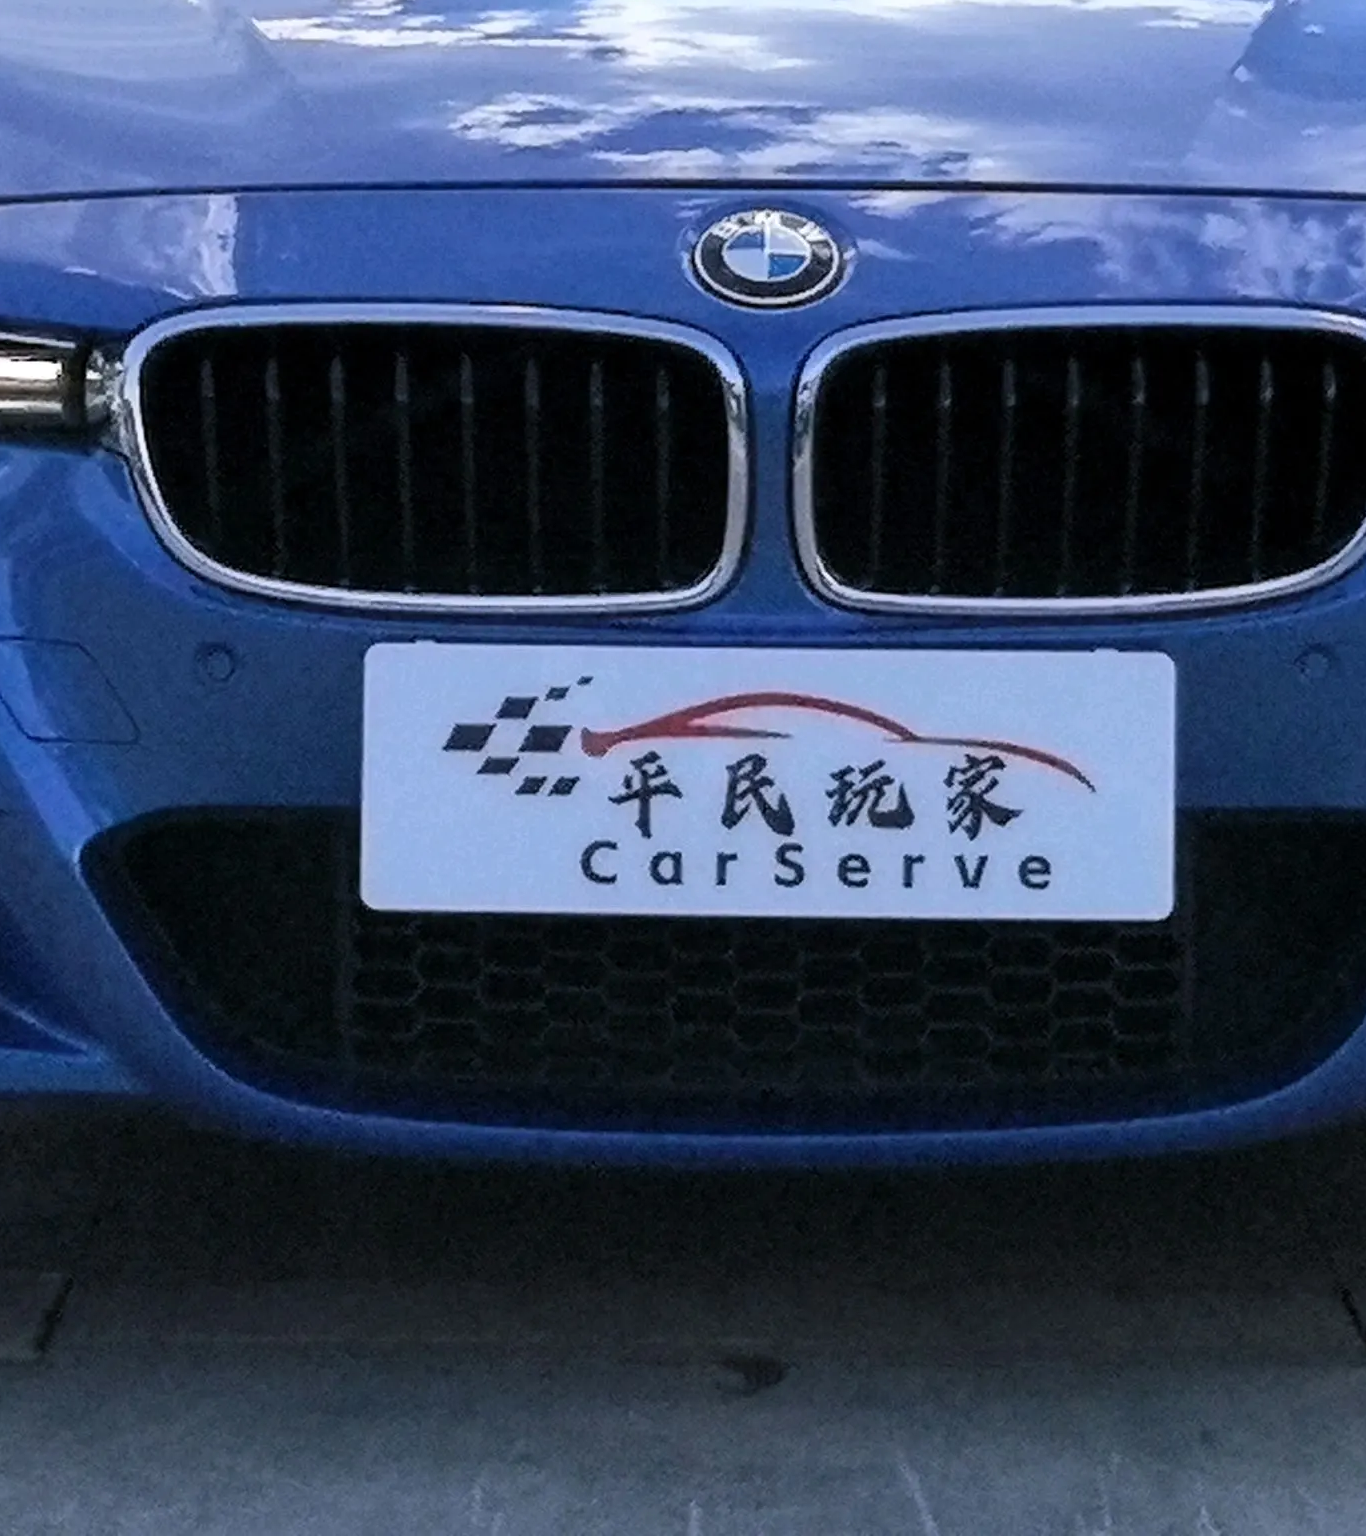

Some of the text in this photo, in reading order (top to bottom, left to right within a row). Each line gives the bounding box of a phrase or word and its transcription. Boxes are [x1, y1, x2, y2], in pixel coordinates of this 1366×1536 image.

[607, 750, 1023, 841] 平民玩家
[580, 840, 1054, 890] CarServe
